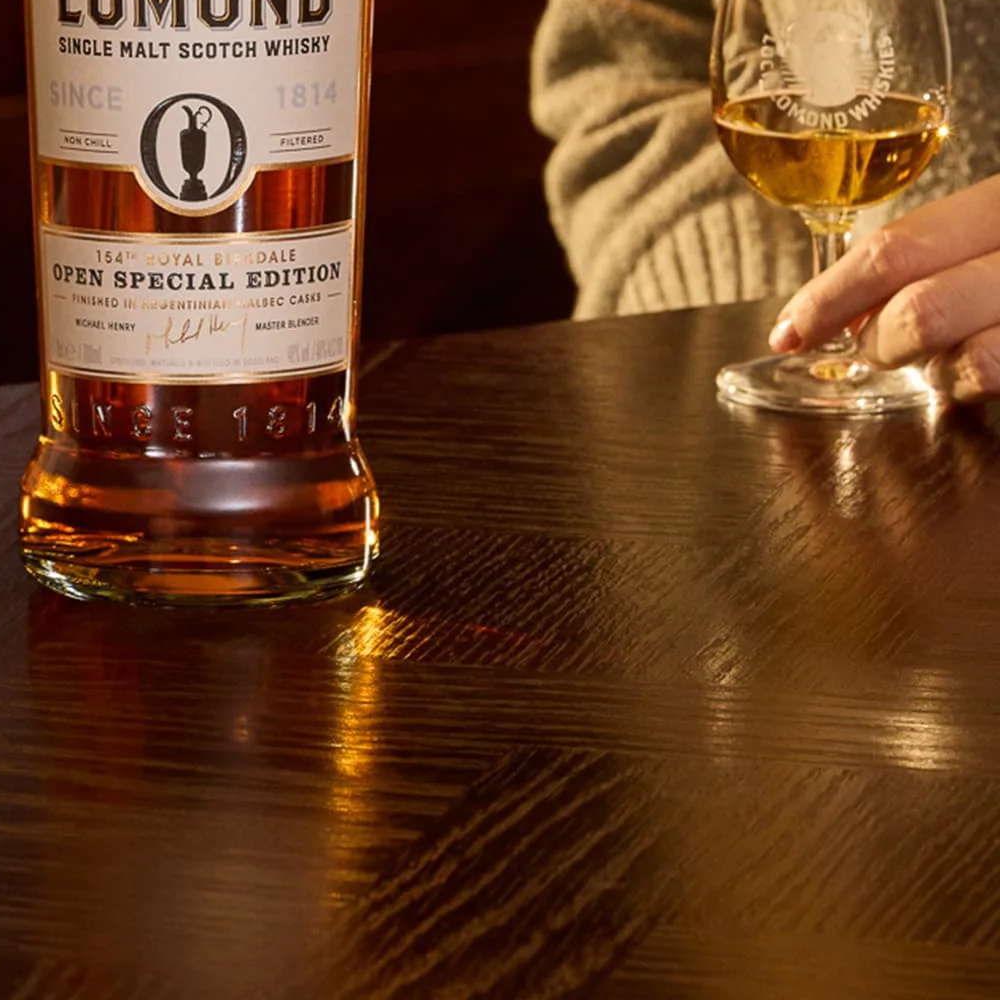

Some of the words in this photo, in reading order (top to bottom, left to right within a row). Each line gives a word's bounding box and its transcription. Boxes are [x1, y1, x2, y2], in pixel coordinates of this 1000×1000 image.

[59, 36, 113, 57] SINGLE
[120, 41, 170, 58] MALT
[179, 41, 257, 59] SCOTCH
[264, 35, 330, 57] WHISKY
[848, 35, 895, 121] WHISKIES
[50, 80, 122, 110] SINCE
[276, 79, 337, 109] 1814
[64, 135, 82, 145] NON
[84, 137, 112, 148] CHILL
[280, 135, 324, 147] FILTERED
[145, 253, 203, 267] ROYAL
[53, 263, 104, 287] OPEN
[114, 270, 234, 291] SPECIAL
[246, 261, 341, 289] EDITION
[72, 293, 119, 308] FINISHED
[289, 292, 321, 305] CASKS
[108, 321, 136, 332] HENRY
[255, 320, 286, 330] MASTER
[288, 316, 319, 328] BLENDER
